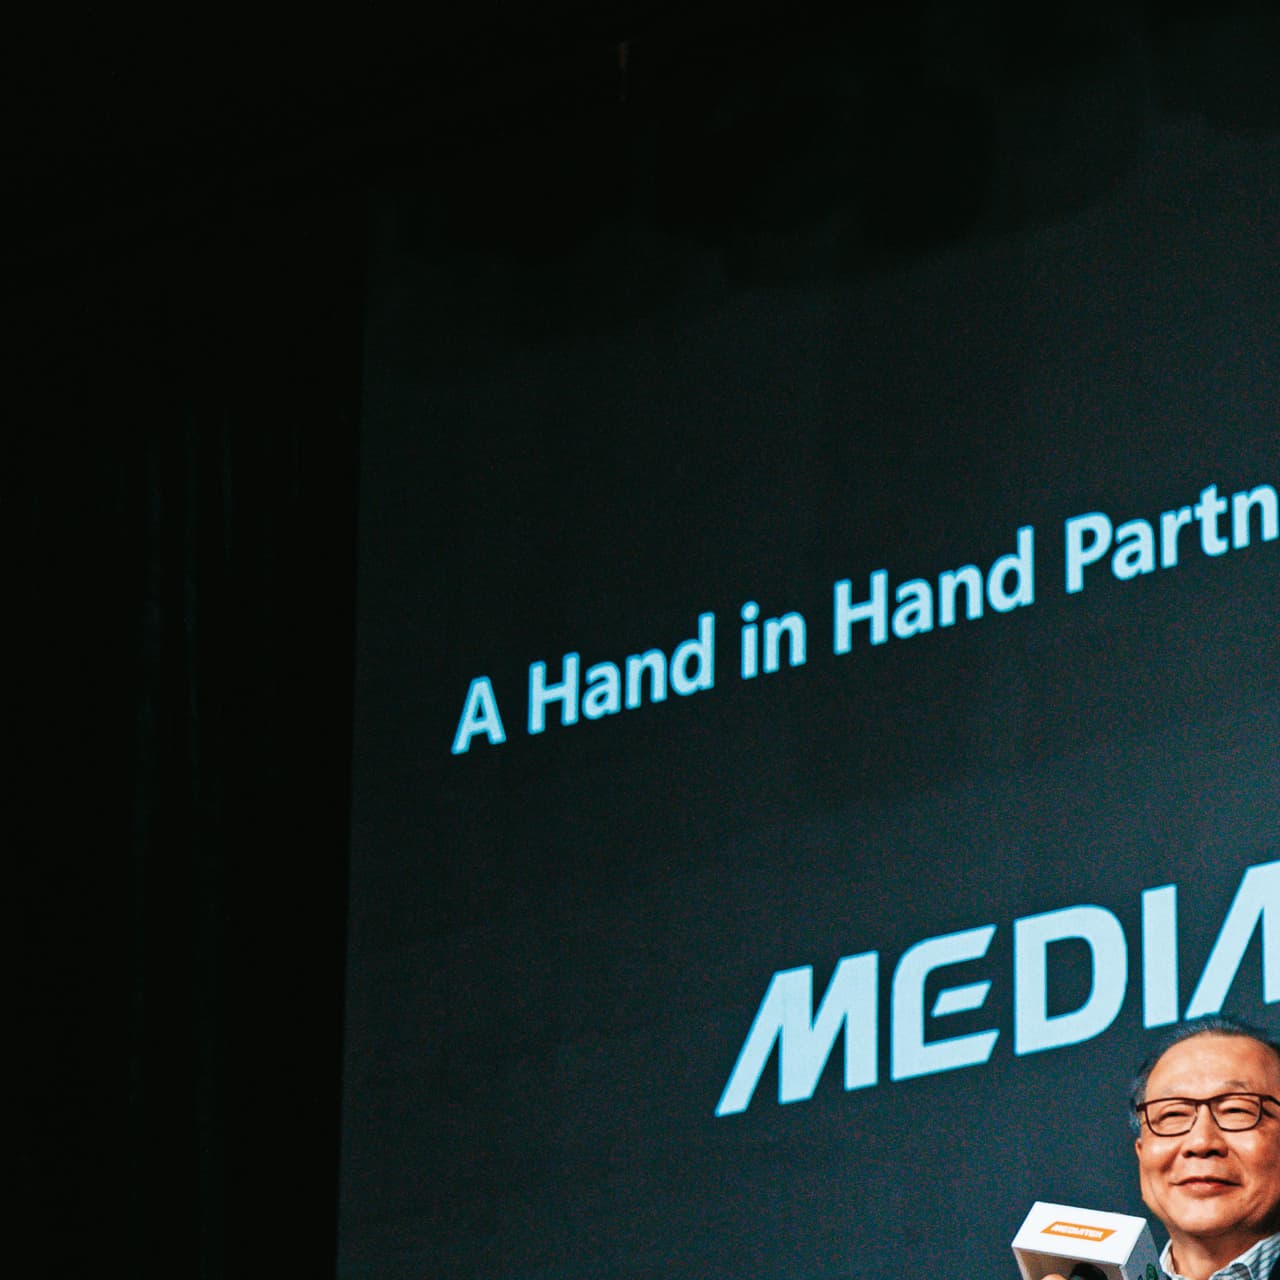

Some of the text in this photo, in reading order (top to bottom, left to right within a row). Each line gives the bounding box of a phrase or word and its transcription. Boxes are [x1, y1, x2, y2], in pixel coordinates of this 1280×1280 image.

[453, 679, 505, 753] A
[529, 614, 714, 733] Hand
[741, 602, 806, 678] in
[836, 528, 1033, 653] Hand
